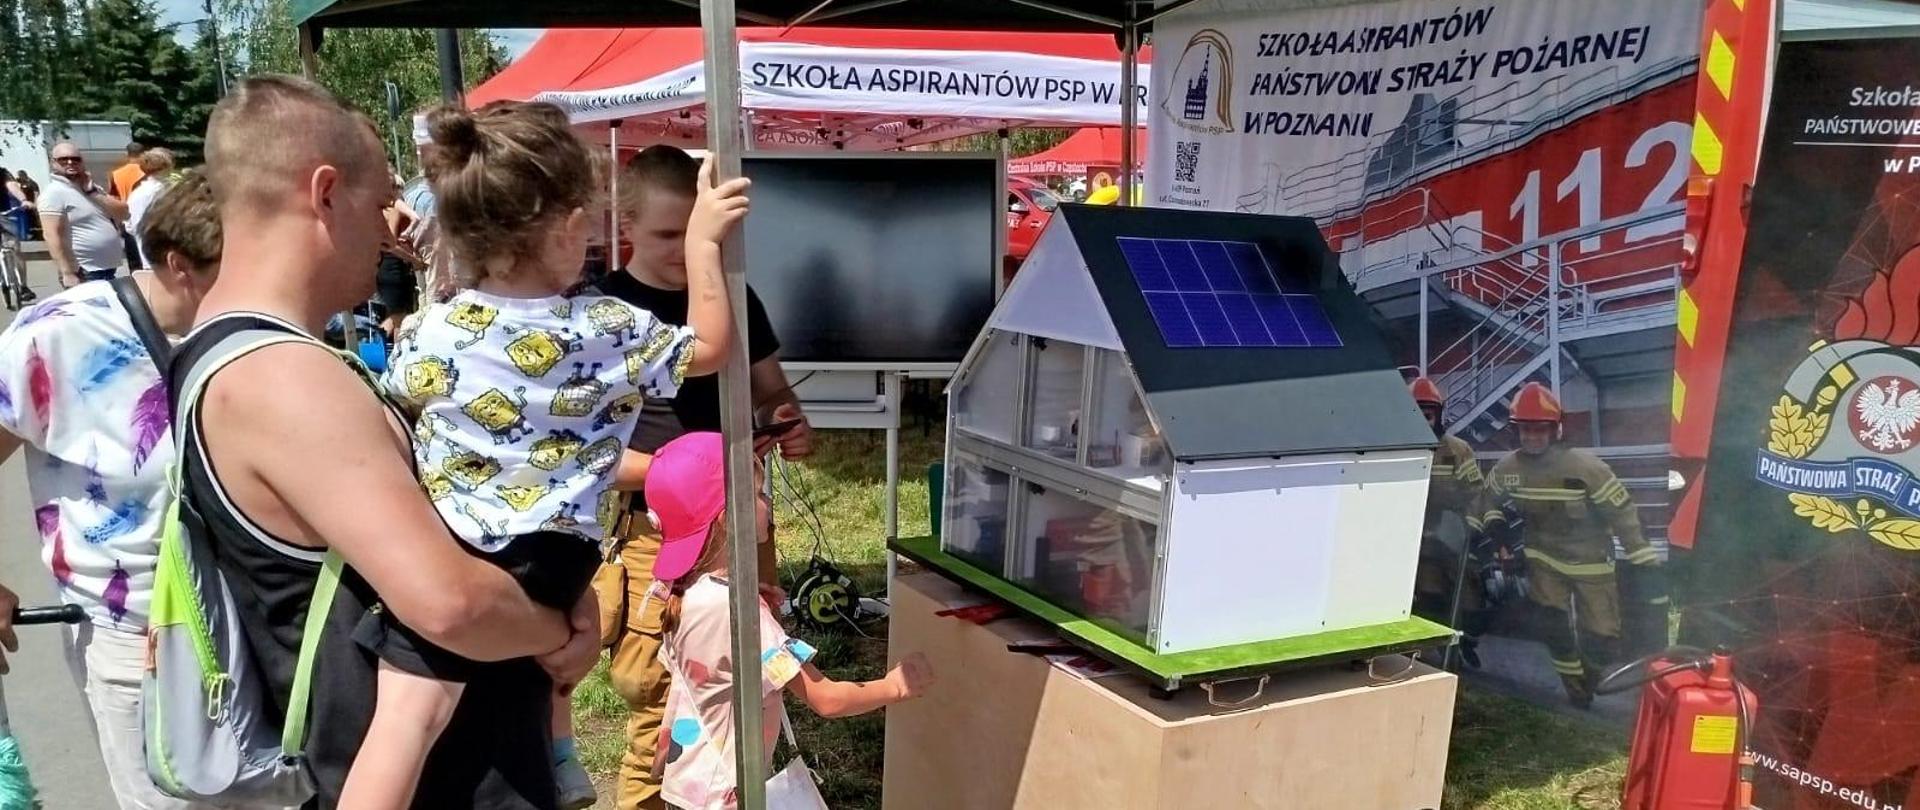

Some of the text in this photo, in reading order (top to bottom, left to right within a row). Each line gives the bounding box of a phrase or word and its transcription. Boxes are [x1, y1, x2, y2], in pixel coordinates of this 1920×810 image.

[1386, 49, 1487, 93] STRAŻY
[1490, 25, 1651, 78] POŻARNEJ
[752, 62, 862, 91] SZKOŁA
[868, 68, 1039, 99] ASPIRANTÓW
[1045, 77, 1086, 102] PSP
[1091, 81, 1115, 104] W
[1849, 85, 1920, 106] Szkoła
[1884, 158, 1904, 173] w
[1509, 121, 1693, 268] 112
[1760, 457, 1847, 489] PAŃSTWOWA
[1856, 467, 1903, 495] STRAŻ
